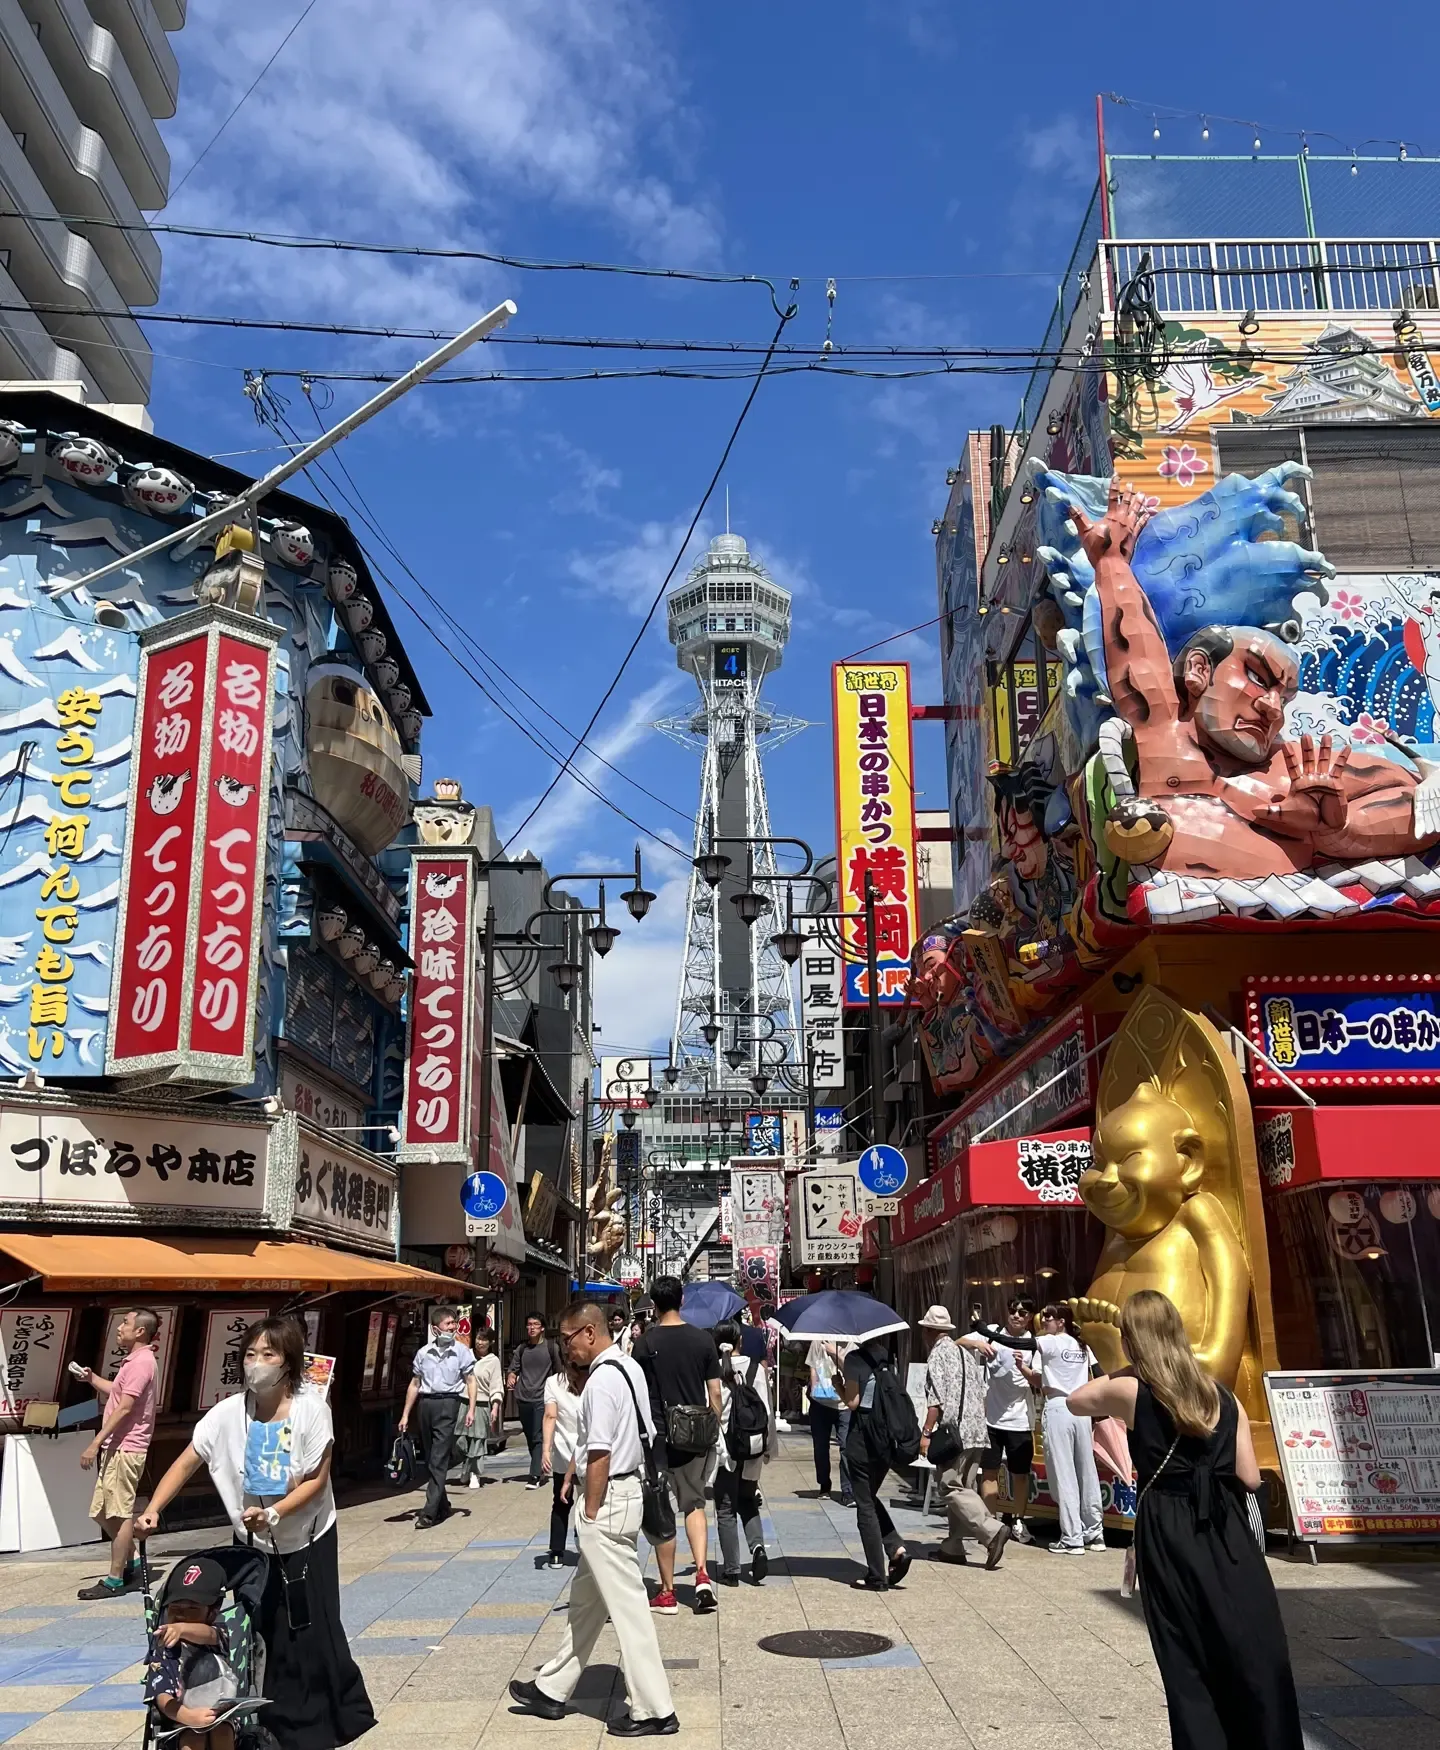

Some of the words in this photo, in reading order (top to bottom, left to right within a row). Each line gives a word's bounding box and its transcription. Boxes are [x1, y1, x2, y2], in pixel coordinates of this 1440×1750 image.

[724, 655, 738, 675] 4
[845, 671, 899, 691] 新世界
[154, 660, 195, 758] 名物
[218, 660, 261, 757] 名物
[857, 694, 892, 844] 日本一の串かつ
[27, 686, 102, 1060] 安うて何んでも旨い
[849, 845, 910, 961] 横綱
[131, 826, 182, 1032] てっちり
[199, 827, 251, 1031] てっちり
[416, 911, 458, 1135] 珍味てっちり
[1268, 1001, 1296, 1064] 新世界
[1297, 1011, 1440, 1050] 日本一の串か
[11, 1137, 257, 1187] づぼらや本店
[296, 1150, 390, 1231] ふぐ料理専門
[468, 1223, 497, 1234] 9-22
[867, 1201, 896, 1213] 9-22
[808, 1252, 815, 1260] 2F
[4, 1315, 35, 1391] にぎり盛合せ
[34, 1314, 55, 1350] ふぐ
[2, 1398, 39, 1412] 1,32
